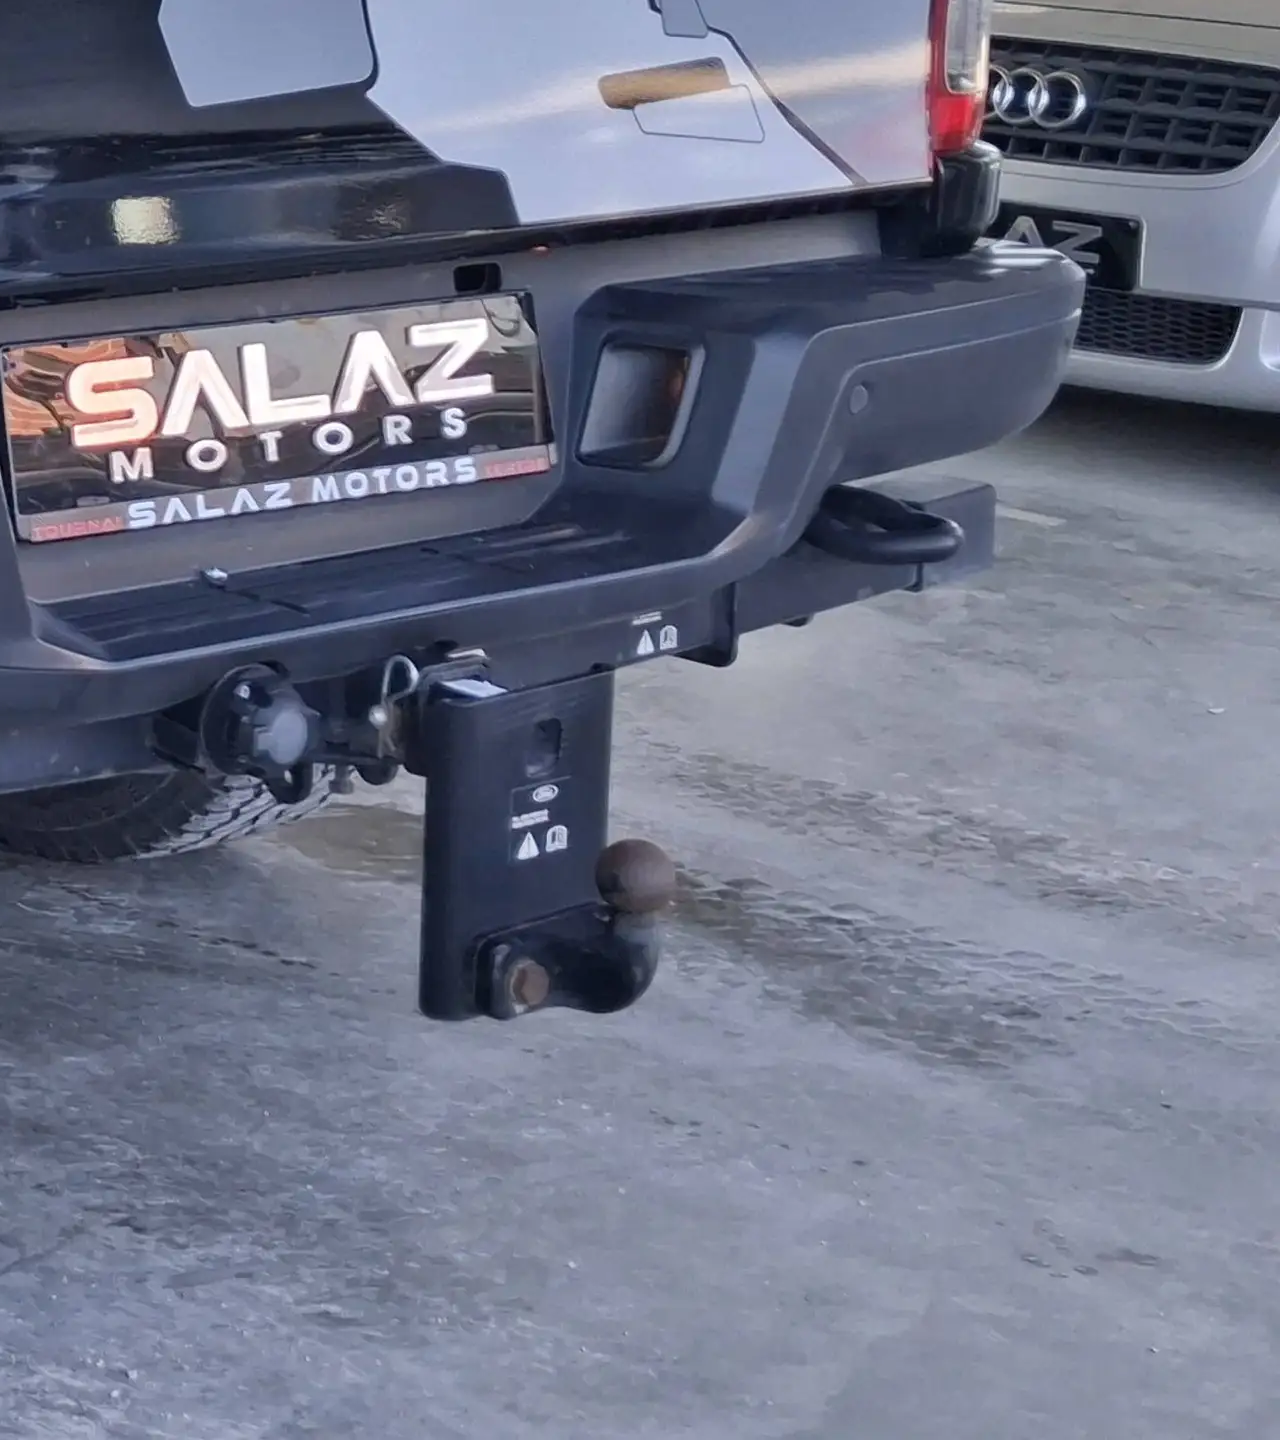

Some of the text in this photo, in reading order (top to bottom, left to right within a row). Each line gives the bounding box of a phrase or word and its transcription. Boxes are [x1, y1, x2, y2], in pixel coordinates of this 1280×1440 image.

[67, 317, 496, 448] SALAZ
[109, 407, 468, 484] MOTORS
[127, 482, 292, 530] SALAZ
[311, 456, 479, 504] MOTORS
